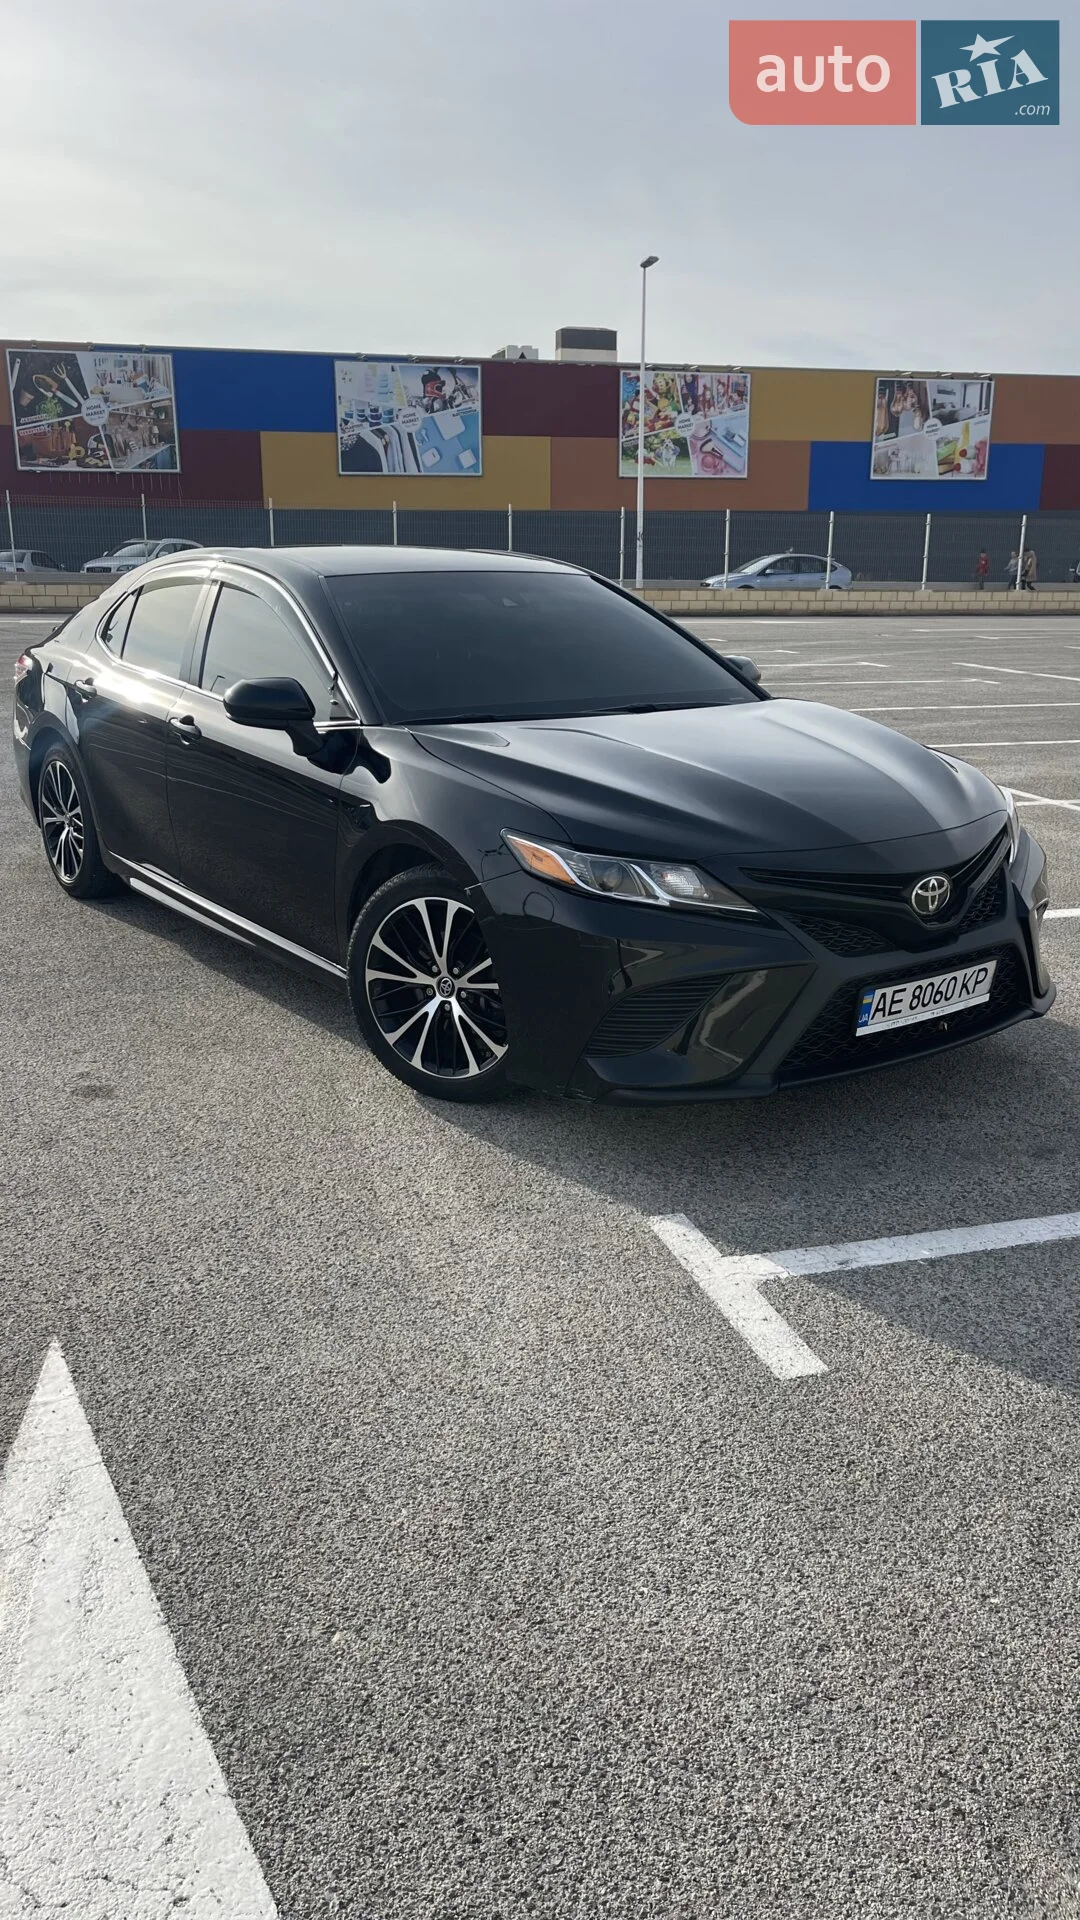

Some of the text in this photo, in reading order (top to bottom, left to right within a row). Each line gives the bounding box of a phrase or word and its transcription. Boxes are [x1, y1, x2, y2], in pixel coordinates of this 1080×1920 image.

[86, 403, 101, 411] HOME
[85, 408, 105, 417] MARKET
[871, 967, 989, 1020] AE 8060 KP
[858, 1014, 869, 1022] UA
